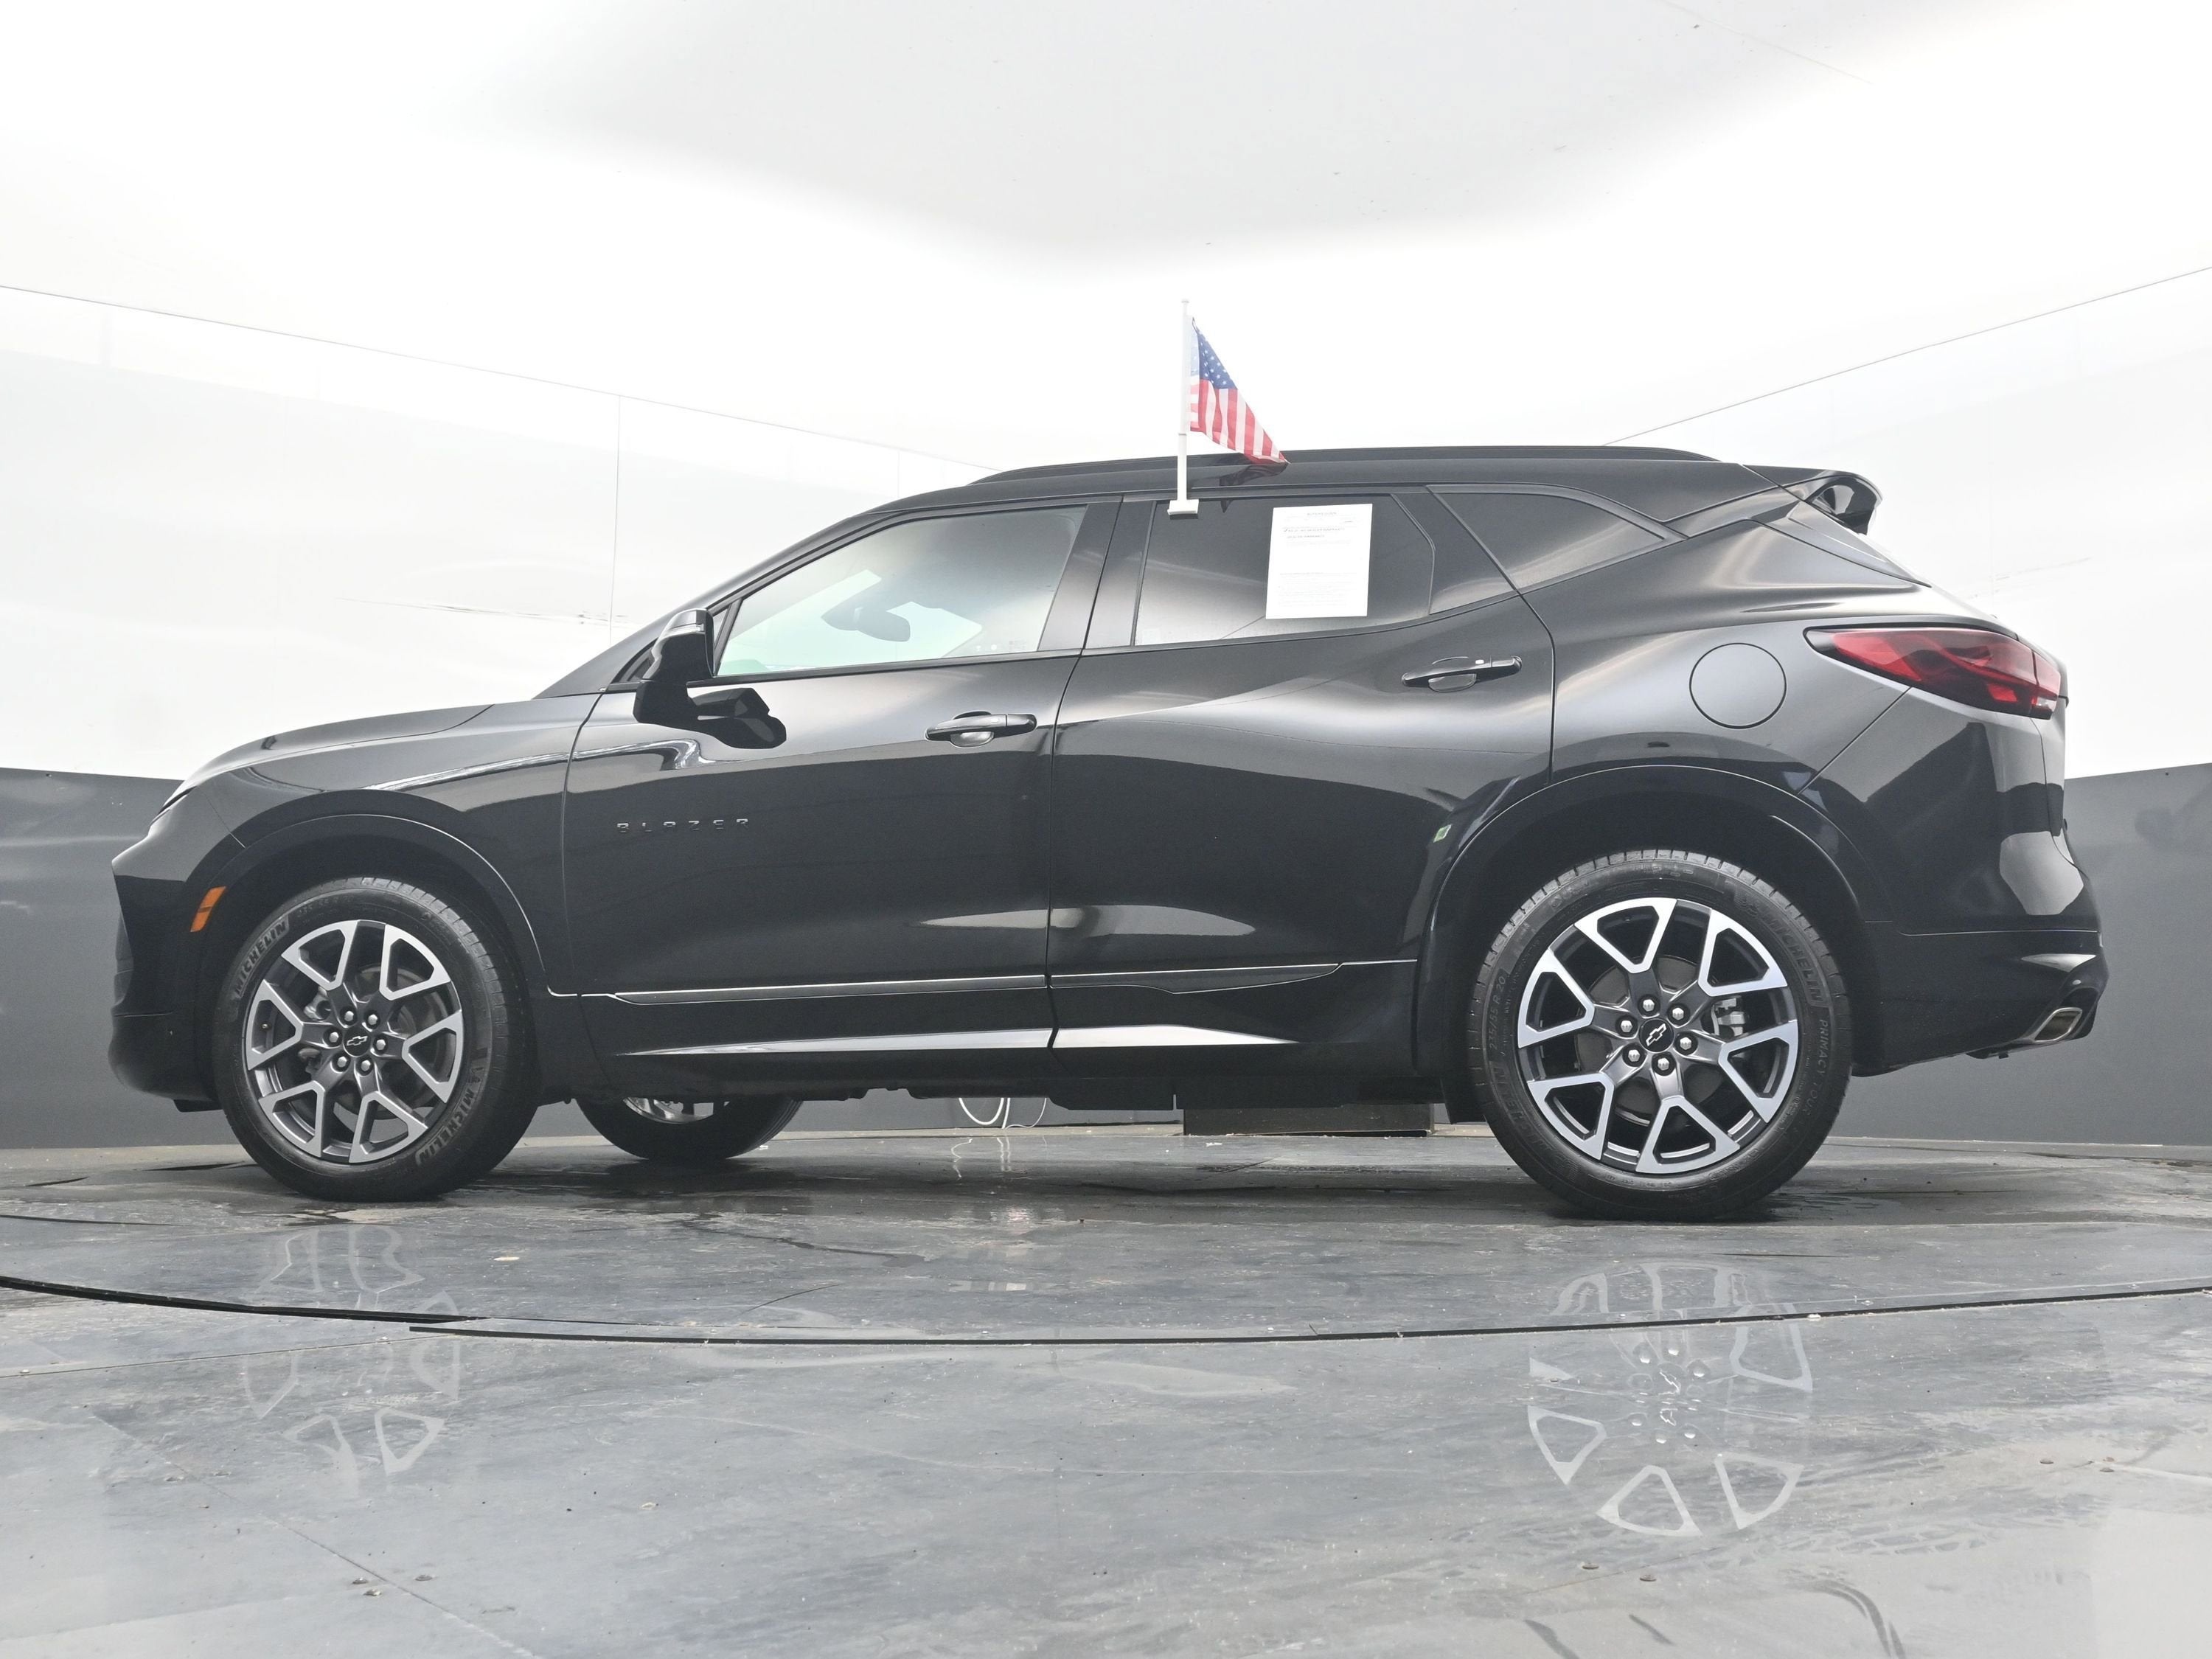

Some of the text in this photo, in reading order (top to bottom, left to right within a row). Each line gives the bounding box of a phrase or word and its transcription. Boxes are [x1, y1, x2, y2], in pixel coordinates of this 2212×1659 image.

[616, 818, 748, 832] BLAZER
[228, 920, 288, 995] MICHELIN
[1492, 995, 1500, 1004] R
[1496, 975, 1506, 992] 20
[1767, 919, 1824, 1001] MICHELIN
[1818, 1019, 1829, 1074] PRIMACY
[418, 1088, 475, 1163] MICHELIN
